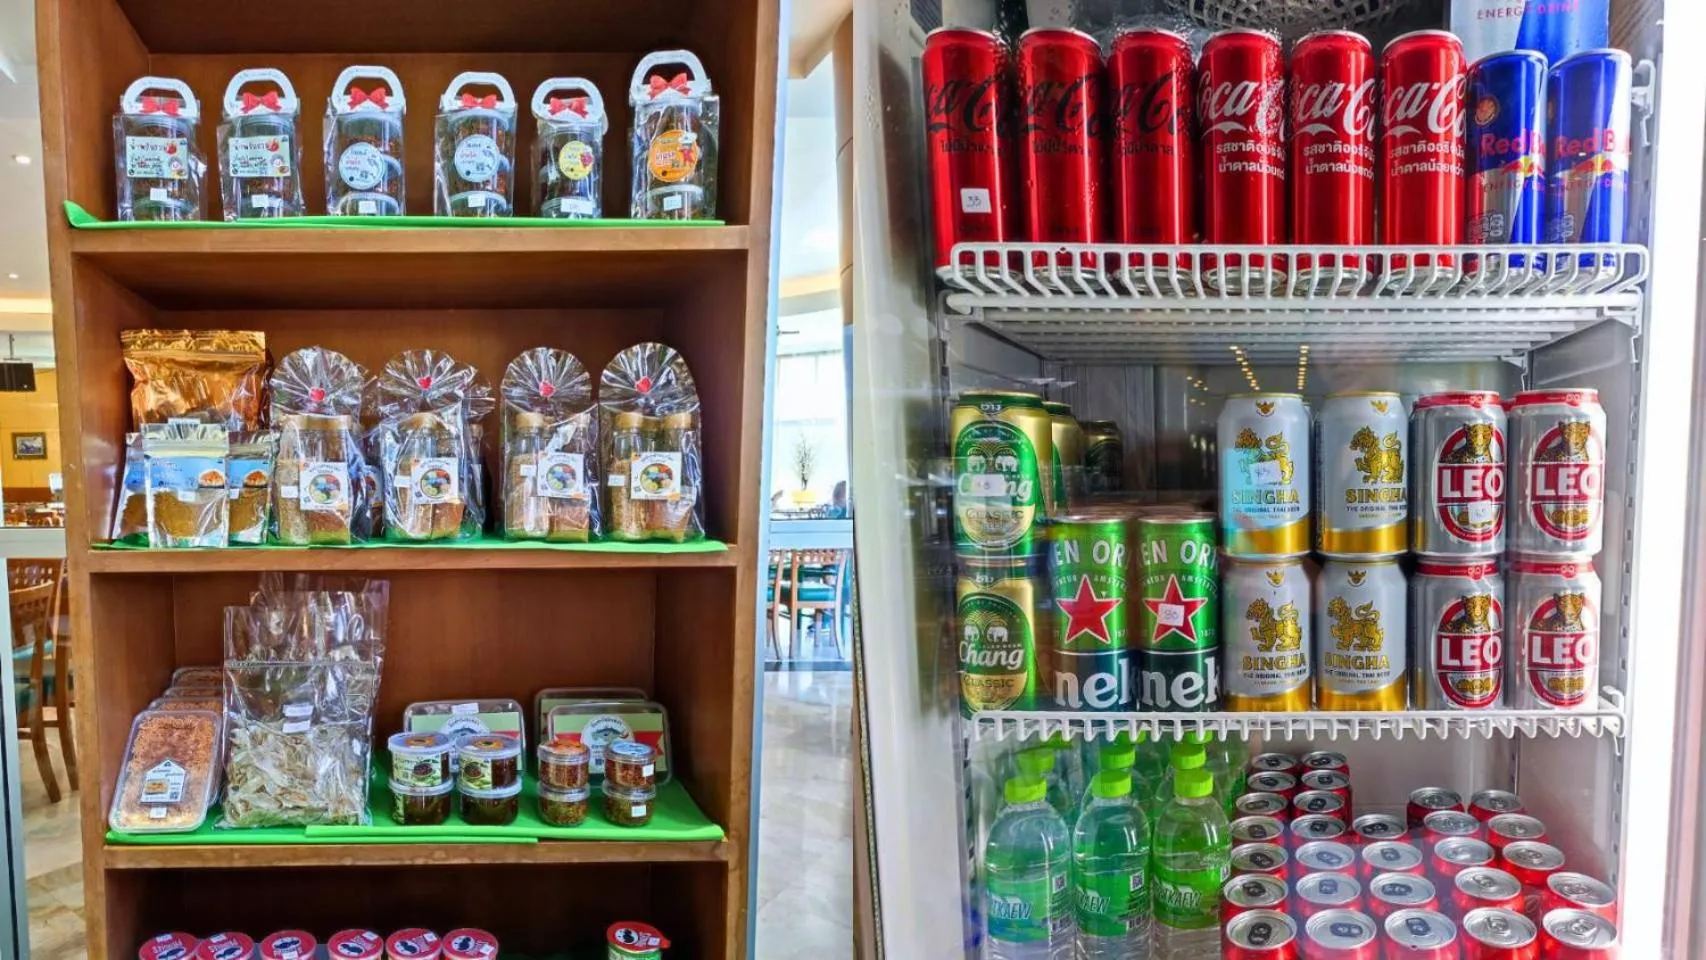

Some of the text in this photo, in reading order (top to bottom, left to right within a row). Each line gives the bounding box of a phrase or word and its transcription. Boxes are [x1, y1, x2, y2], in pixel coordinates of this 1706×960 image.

[1481, 128, 1527, 156] Red
[1555, 128, 1600, 156] Red
[957, 472, 1033, 504] Cng
[1441, 467, 1505, 498] LEO
[1535, 466, 1601, 496] LEO
[1231, 488, 1300, 505] SINGHA
[959, 640, 1026, 671] Chang
[1242, 652, 1307, 671] SINGHA
[1441, 634, 1502, 667] LEO
[1532, 634, 1597, 665] LEO
